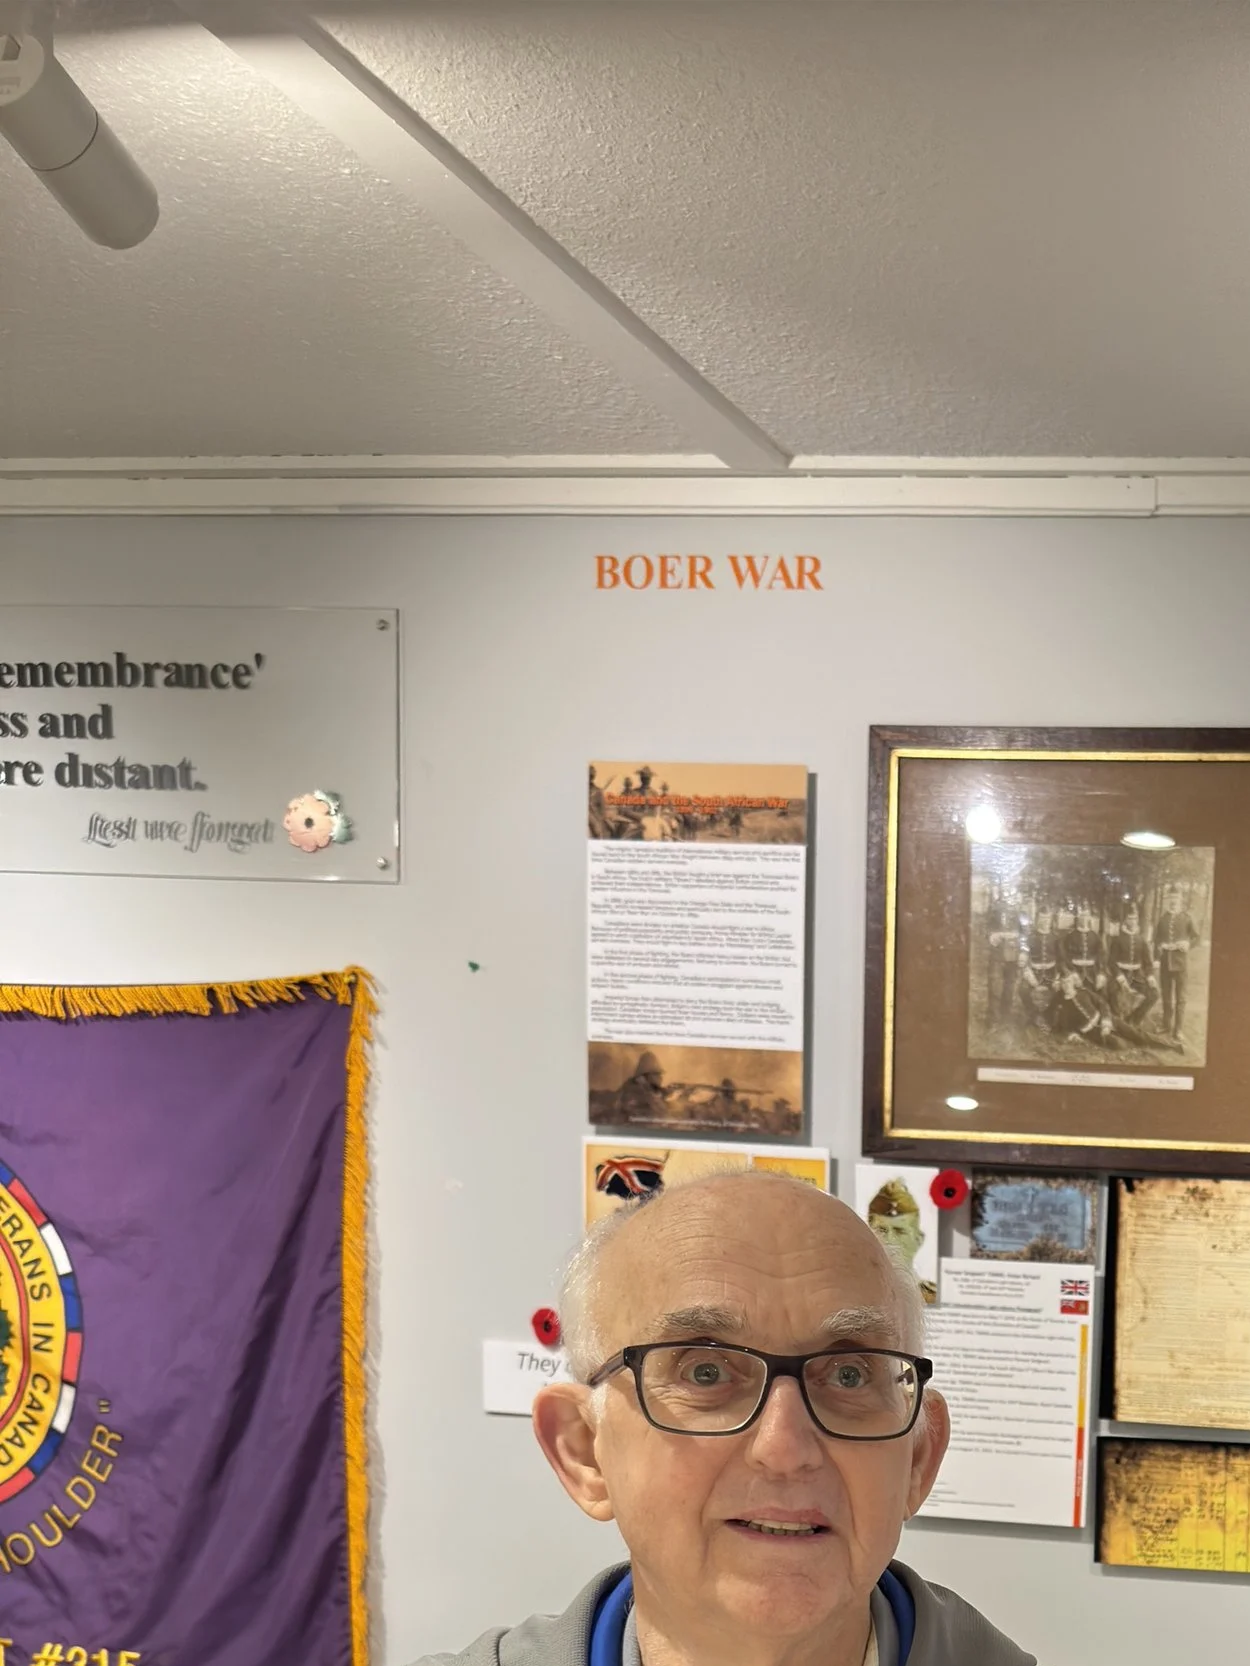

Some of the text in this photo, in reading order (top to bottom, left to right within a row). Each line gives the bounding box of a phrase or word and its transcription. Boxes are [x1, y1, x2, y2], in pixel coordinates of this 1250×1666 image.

[594, 554, 823, 591] BOER WAR
[39, 703, 115, 739] and
[0, 752, 207, 791] re distant.
[31, 1322, 54, 1353] IN
[517, 1351, 561, 1377] They
